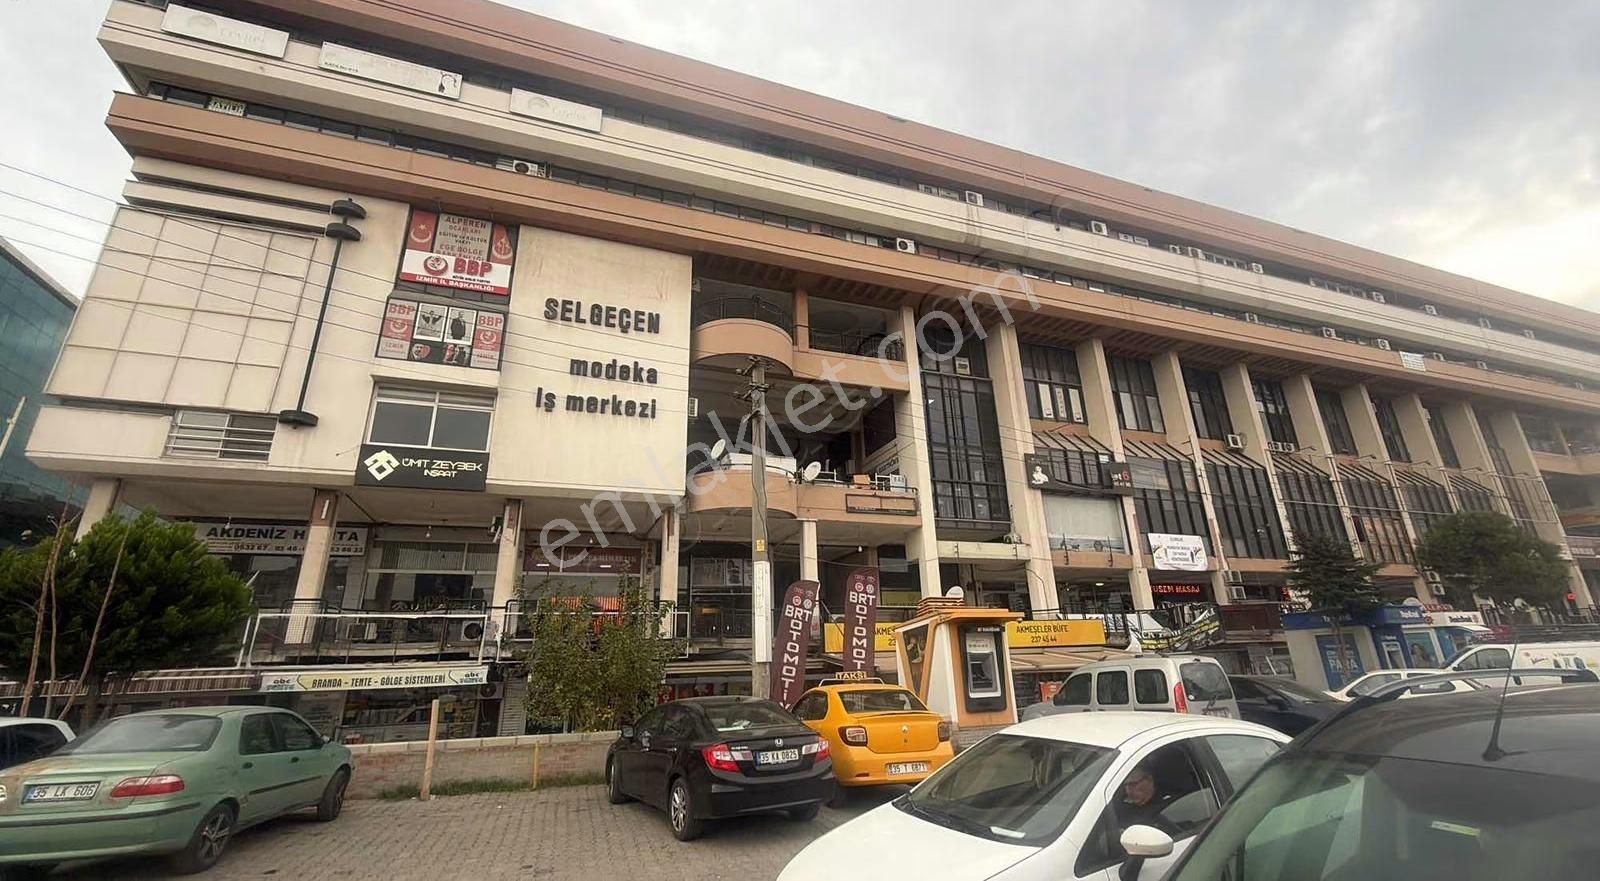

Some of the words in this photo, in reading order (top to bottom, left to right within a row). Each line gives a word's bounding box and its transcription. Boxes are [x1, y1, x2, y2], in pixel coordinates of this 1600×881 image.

[446, 216, 487, 229] ALPEREN
[453, 257, 492, 277] BBP
[388, 303, 415, 315] BBP
[543, 297, 660, 334] SELGEÇEN
[478, 315, 503, 327] BBP
[569, 358, 658, 384] modeka
[565, 394, 657, 419] merkezi
[431, 459, 483, 472] ZEYBEK
[207, 526, 286, 540] AKDENİZ
[849, 591, 876, 606] BRT
[784, 604, 812, 622] BRT
[1016, 624, 1052, 634] AKMEŞELER
[1053, 624, 1068, 633] BÜFE
[312, 679, 342, 688] BRANDA
[351, 676, 373, 687] TENTE
[404, 673, 446, 684] SİSTEMLERİ
[761, 753, 770, 762] 35
[781, 750, 798, 760] 0825
[33, 787, 49, 798] 35
[54, 785, 69, 797] LK
[74, 784, 96, 796] 606
